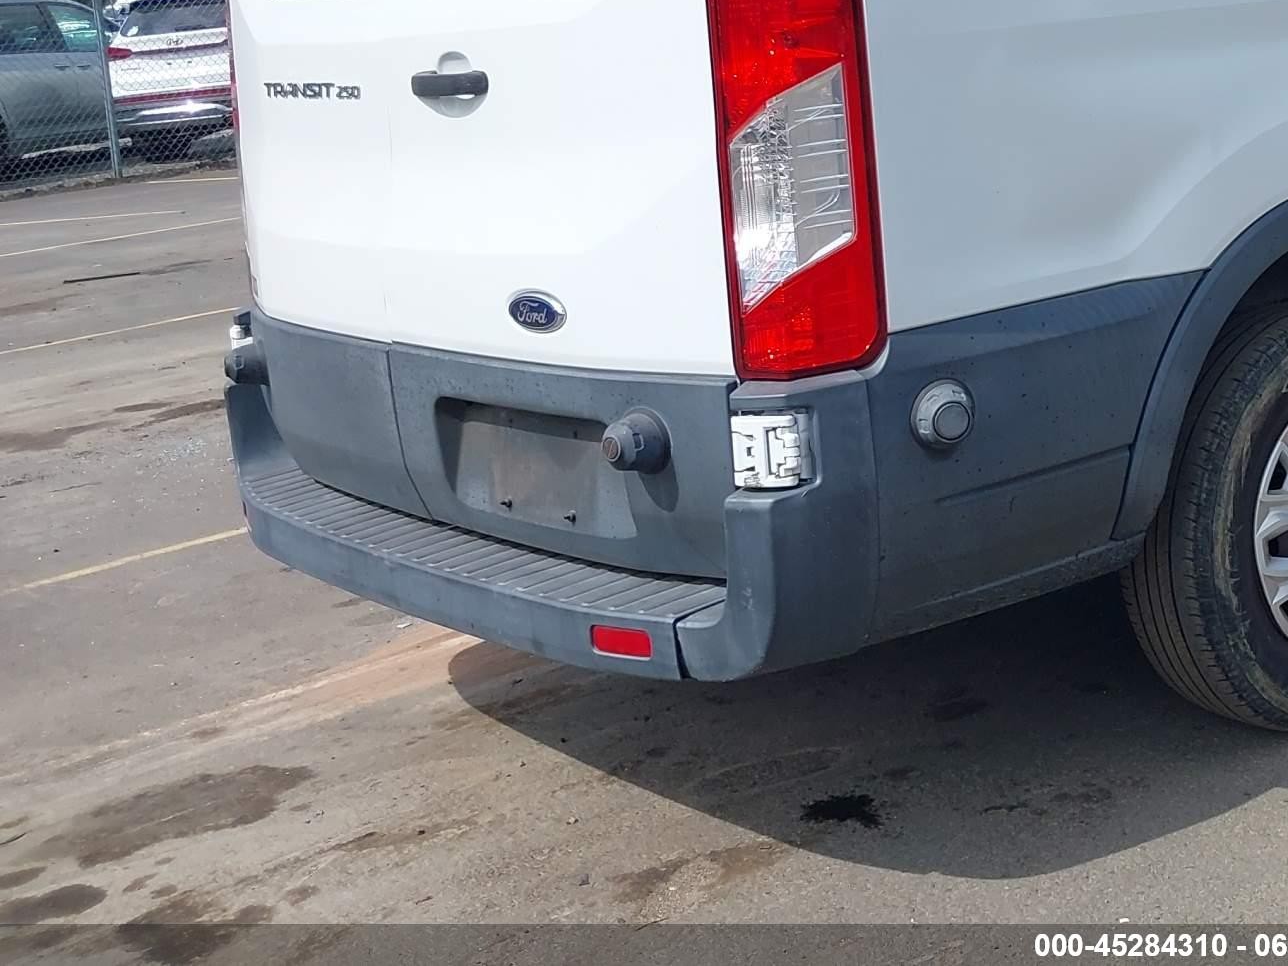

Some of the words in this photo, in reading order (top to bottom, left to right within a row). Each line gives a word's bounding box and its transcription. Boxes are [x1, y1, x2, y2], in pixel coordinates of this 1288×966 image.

[264, 82, 334, 98] TRANSIT
[336, 85, 361, 100] 250
[518, 300, 548, 324] Ford
